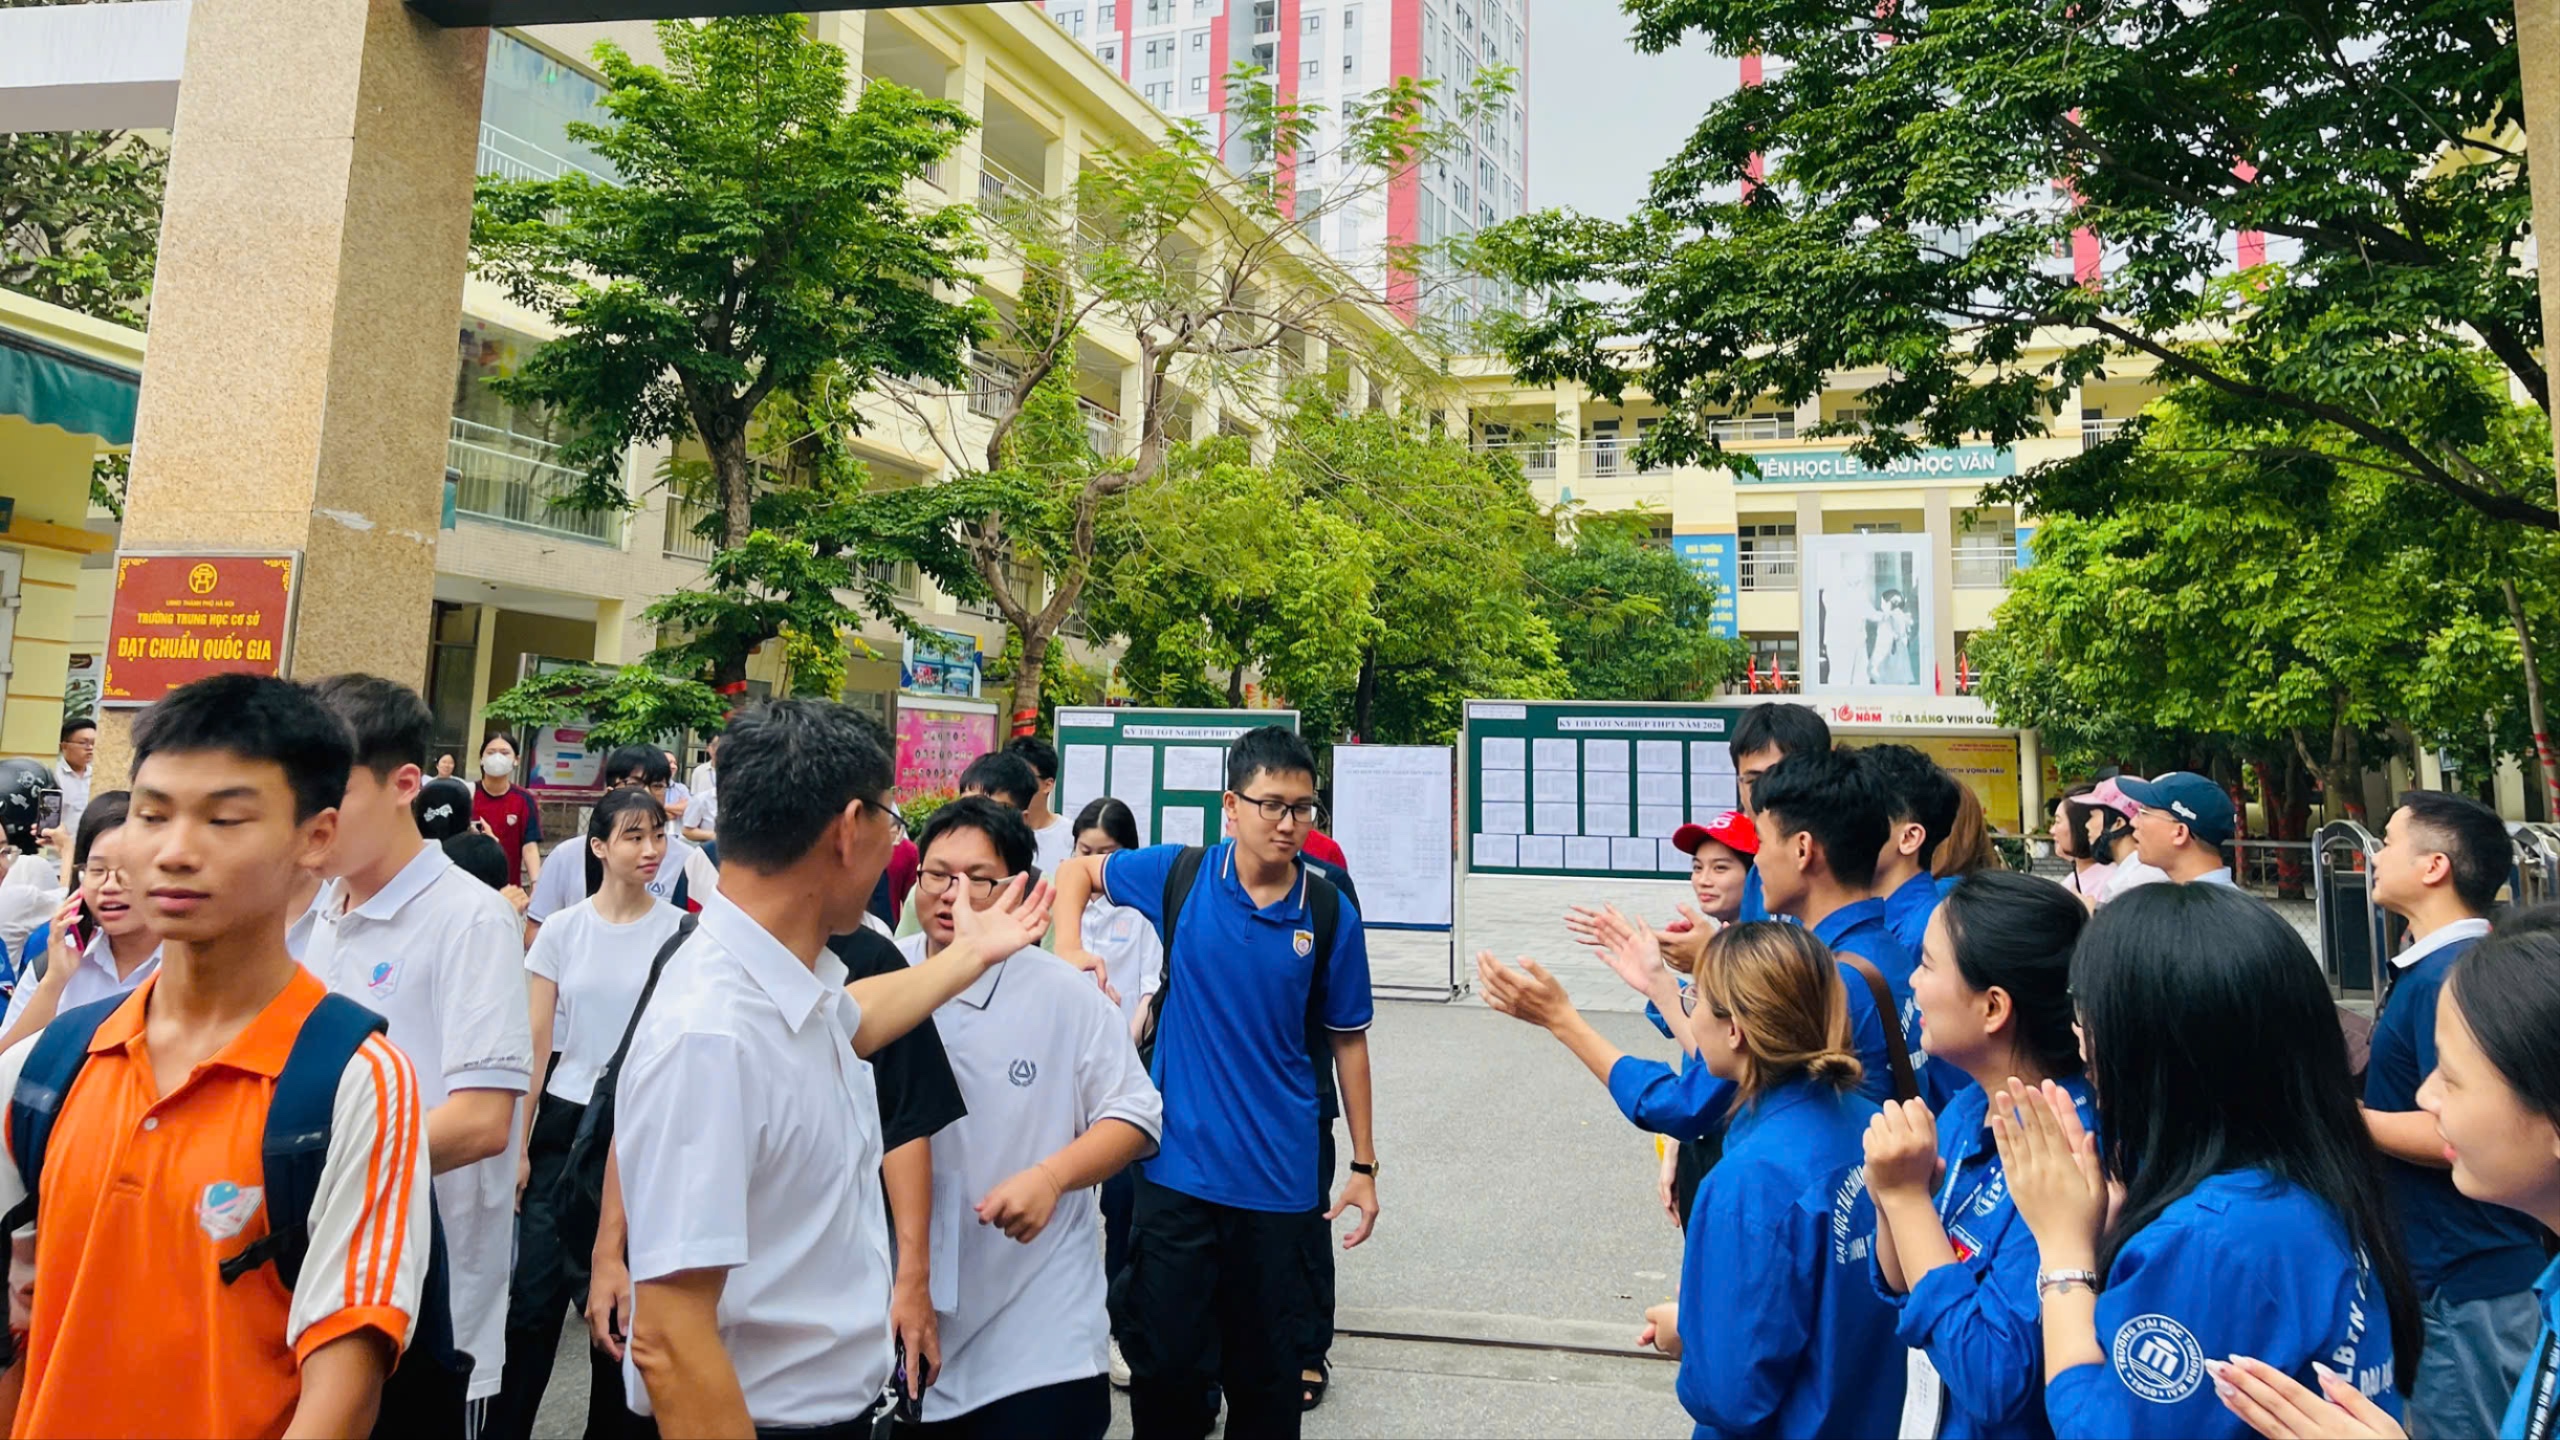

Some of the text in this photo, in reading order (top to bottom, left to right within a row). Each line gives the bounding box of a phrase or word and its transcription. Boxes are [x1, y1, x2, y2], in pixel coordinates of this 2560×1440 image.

[1793, 460, 1831, 480] HỌC
[1914, 456, 1953, 476] HỌC
[1958, 451, 1996, 471] VĂN
[137, 610, 260, 628] TRƯỜNG TRUNG HỌC CƠ SỞ
[118, 630, 272, 662] ĐẠT CHUẨN QUỐC GIA
[1575, 720, 1592, 728] THI
[1613, 720, 1650, 731] NGHIỆP
[1650, 721, 1677, 730] THPT
[1679, 719, 1701, 730] NĂM
[1703, 721, 1722, 730] 2026
[1947, 715, 1974, 724] VINH
